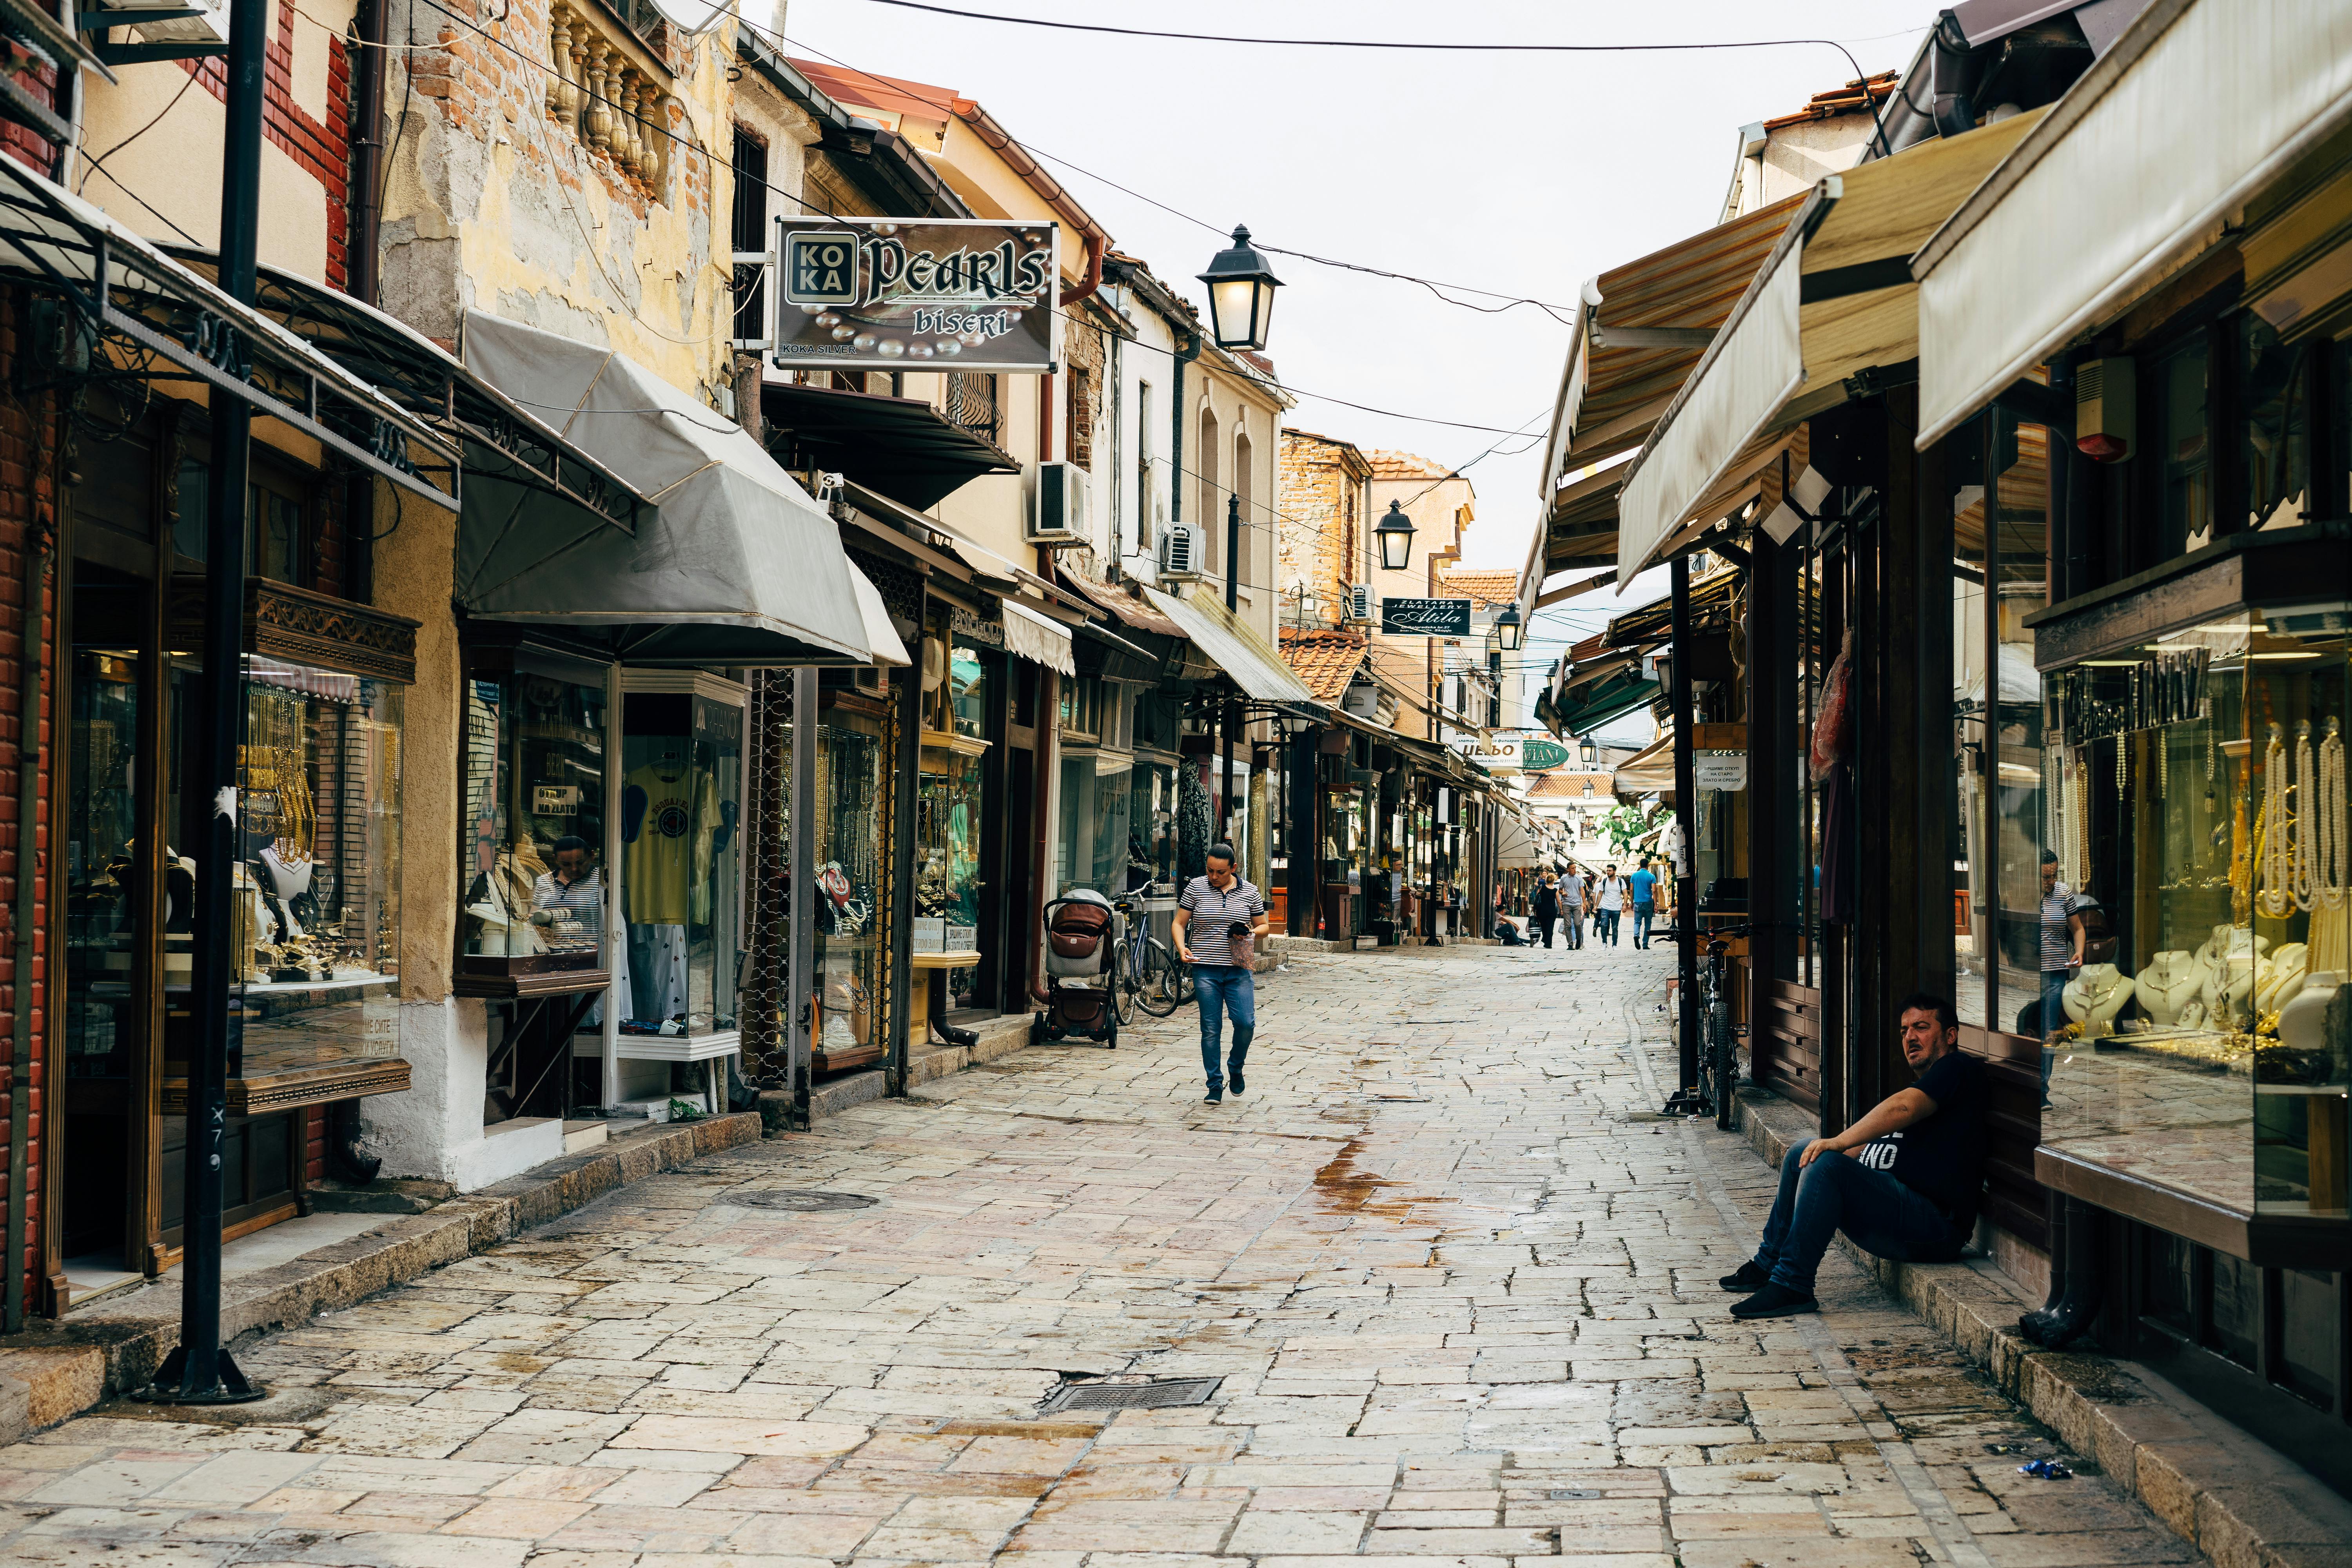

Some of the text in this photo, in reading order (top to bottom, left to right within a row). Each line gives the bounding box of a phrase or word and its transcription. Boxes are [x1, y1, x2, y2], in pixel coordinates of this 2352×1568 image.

[913, 308, 1014, 339] biseri
[783, 345, 857, 354] KOKA SILVER
[1391, 608, 1461, 623] Atila
[546, 752, 565, 778] BERK
[538, 804, 576, 814] NA ZLATO
[375, 1019, 390, 1034] СИТЕ
[371, 1040, 394, 1056] УСЛУГИ
